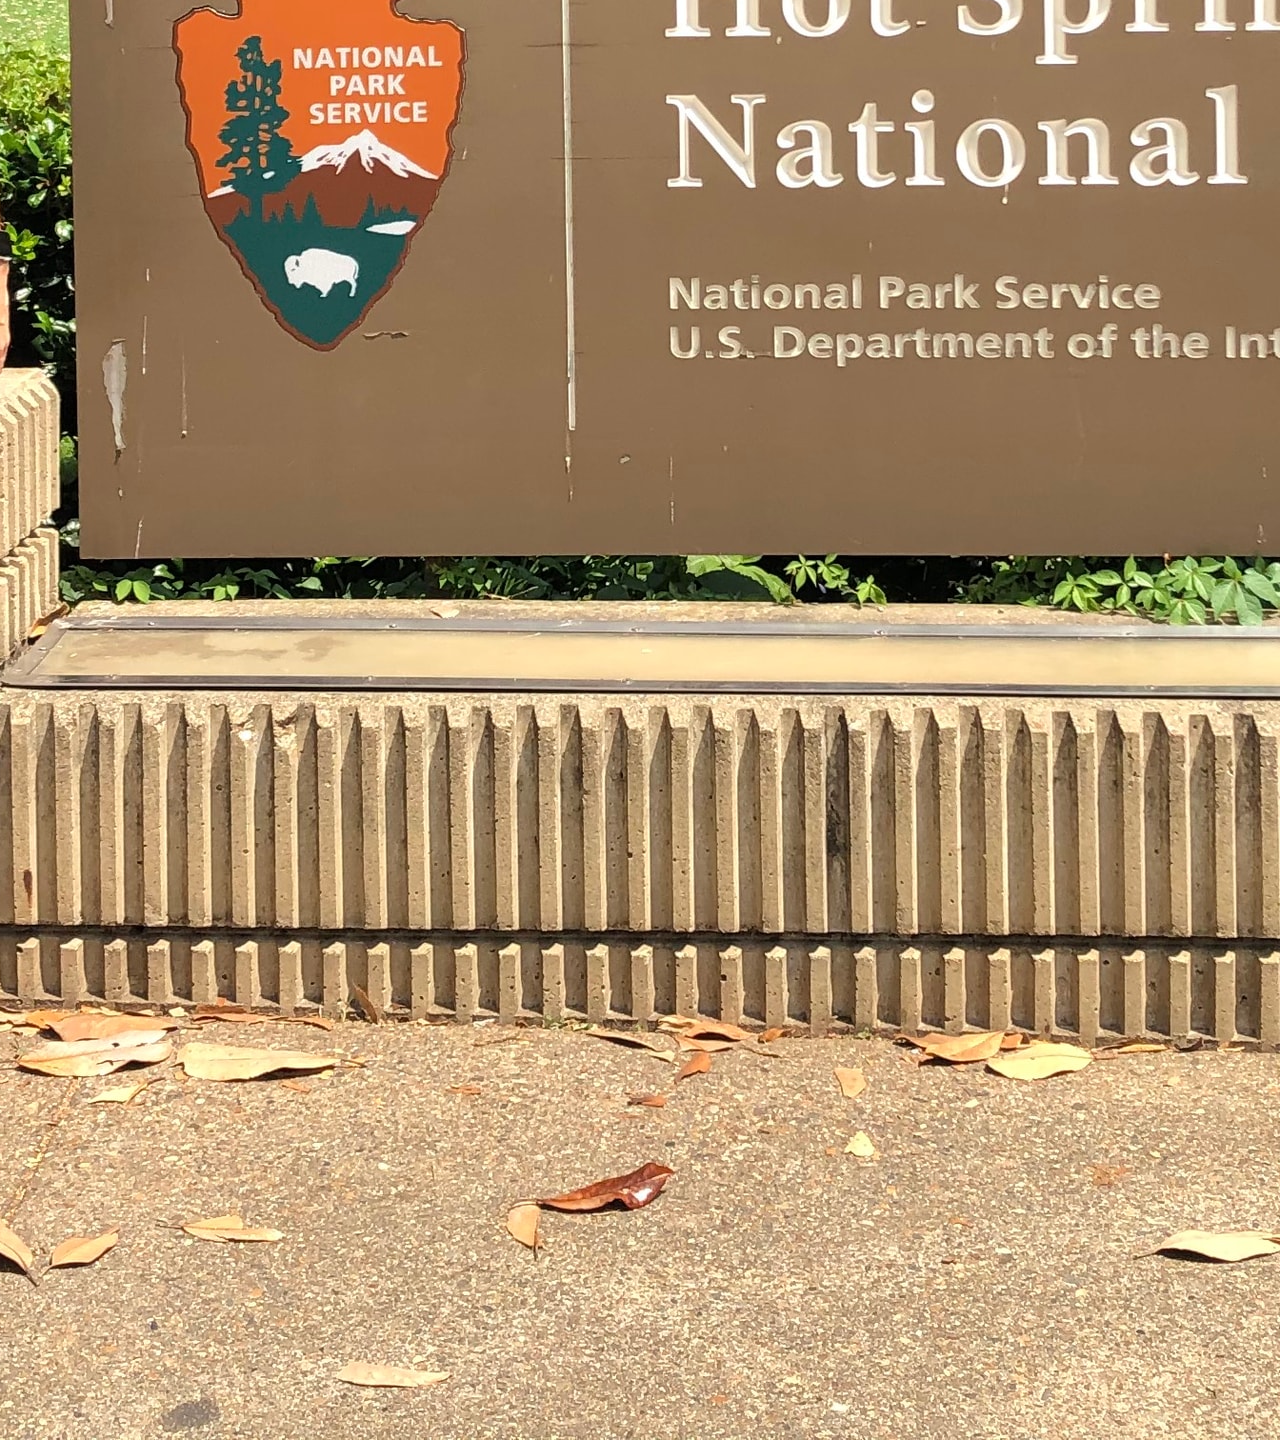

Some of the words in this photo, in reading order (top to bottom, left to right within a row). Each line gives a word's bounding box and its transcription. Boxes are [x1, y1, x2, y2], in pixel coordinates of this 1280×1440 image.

[293, 45, 443, 69] NATIONAL
[330, 73, 406, 96] PARK
[309, 101, 428, 125] SERVICE
[665, 84, 1249, 190] National
[668, 274, 863, 310] National
[878, 274, 981, 310] Park
[994, 275, 1162, 310] Service
[669, 325, 754, 360] U.S.
[772, 325, 1055, 367] Department
[1066, 323, 1119, 360] of
[1130, 323, 1210, 360] the
